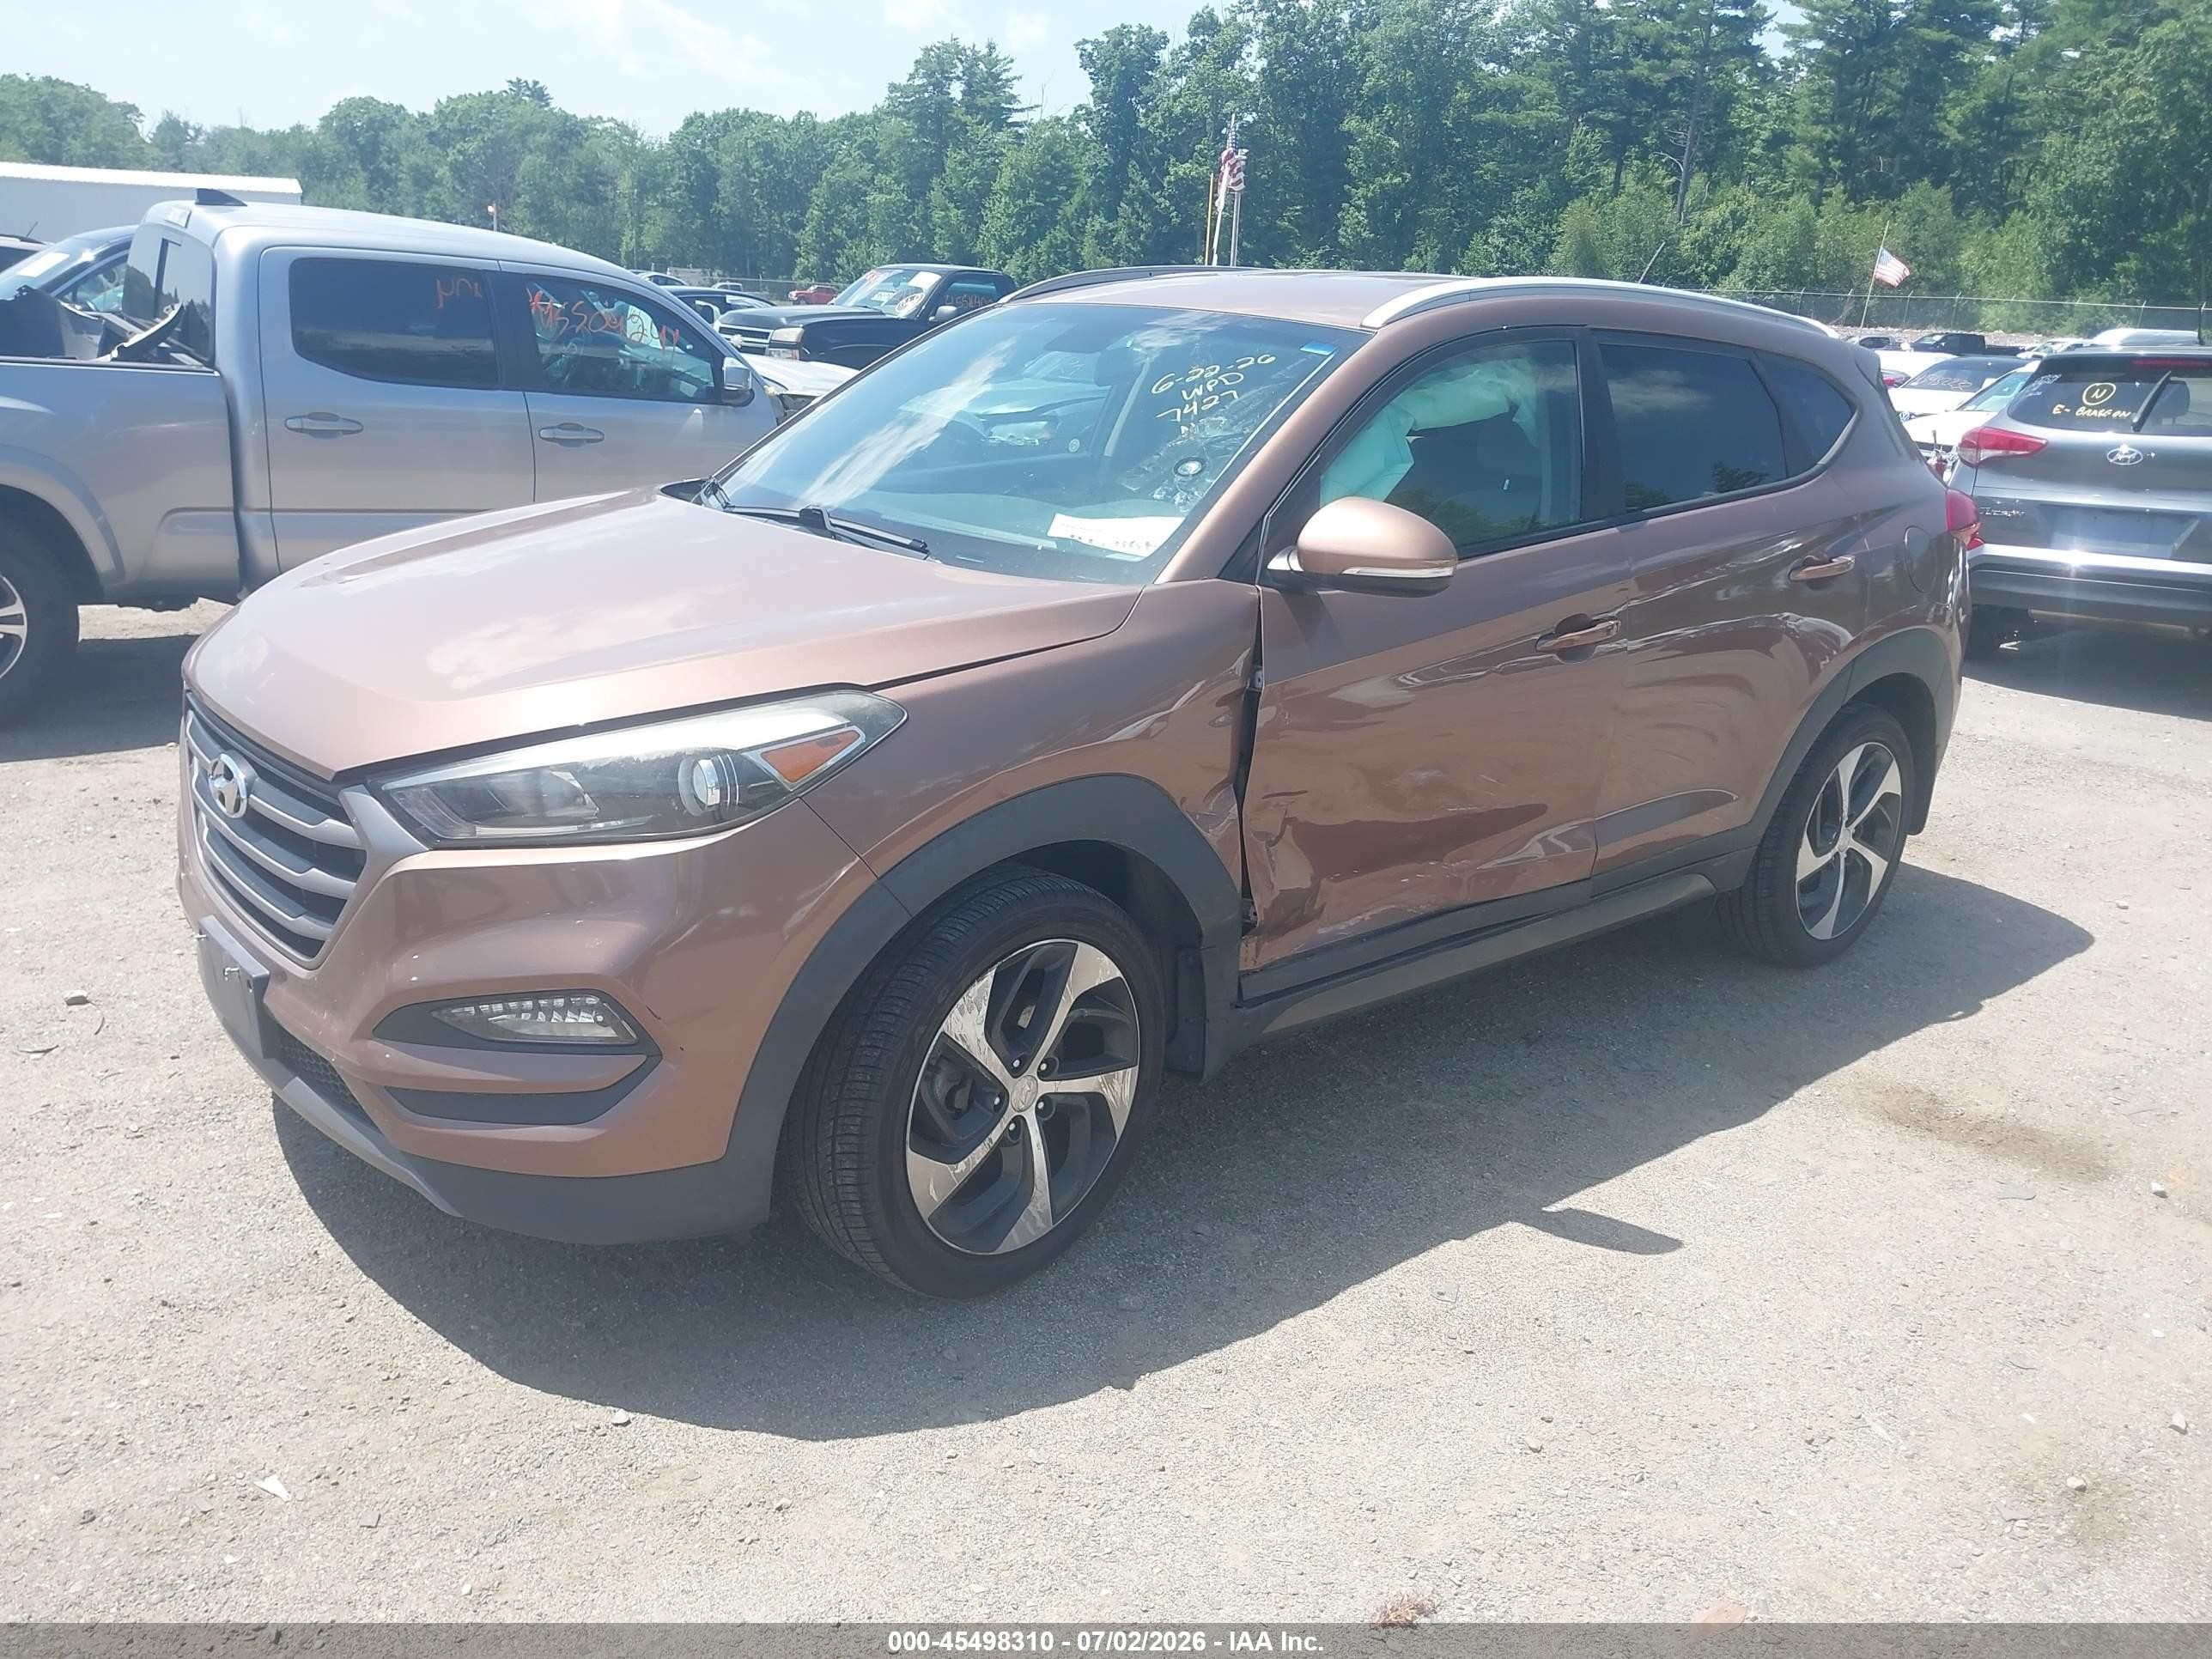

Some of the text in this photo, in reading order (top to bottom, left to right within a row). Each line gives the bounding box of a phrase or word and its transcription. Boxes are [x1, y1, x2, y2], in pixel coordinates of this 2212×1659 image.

[1152, 354, 1276, 393] 6-22-26
[1182, 373, 1243, 400] WPD
[1156, 391, 1238, 422] 7427
